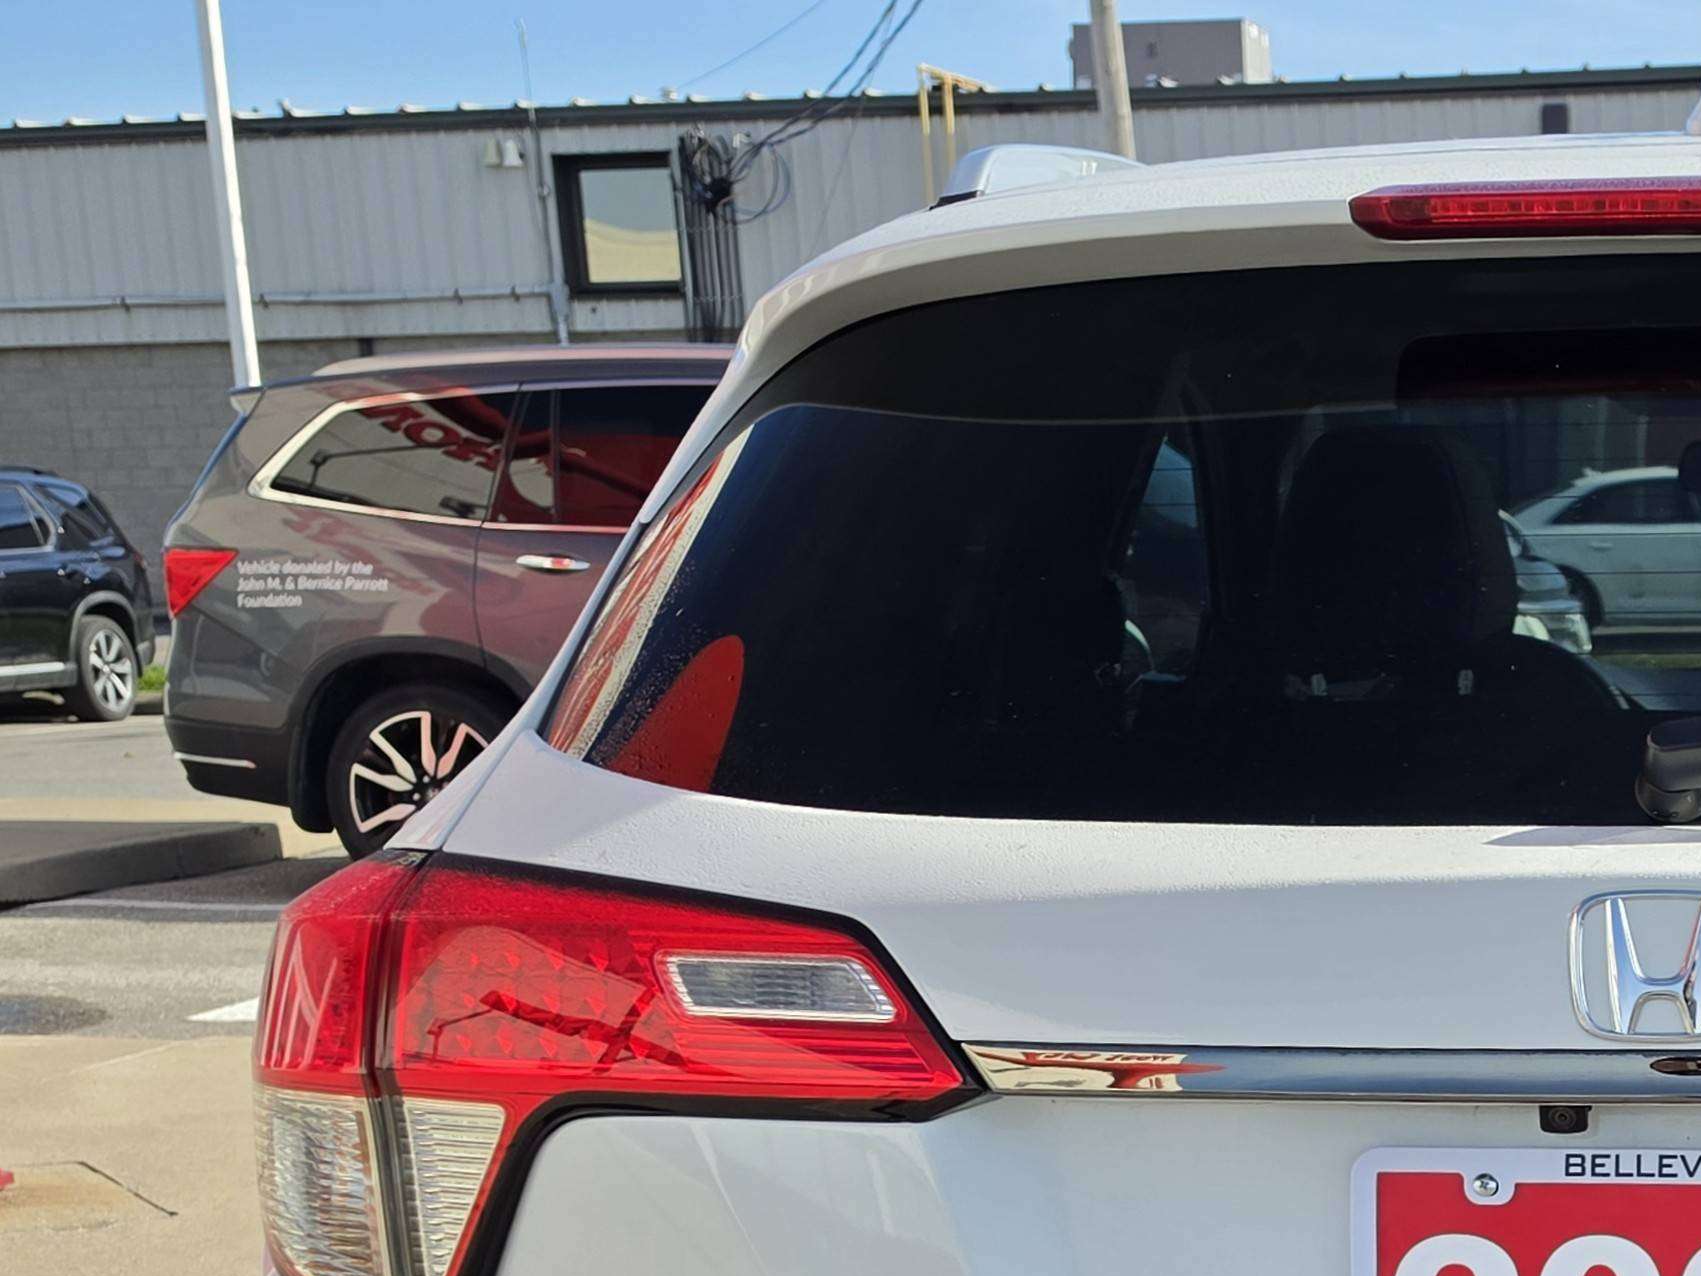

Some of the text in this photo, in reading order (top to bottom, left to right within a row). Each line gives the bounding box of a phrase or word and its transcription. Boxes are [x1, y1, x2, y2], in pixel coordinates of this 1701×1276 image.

[237, 560, 373, 576] Vehicle donated by the
[237, 577, 265, 591] John
[284, 578, 296, 590] &
[297, 576, 343, 591] Bernice
[237, 593, 302, 608] Foundation
